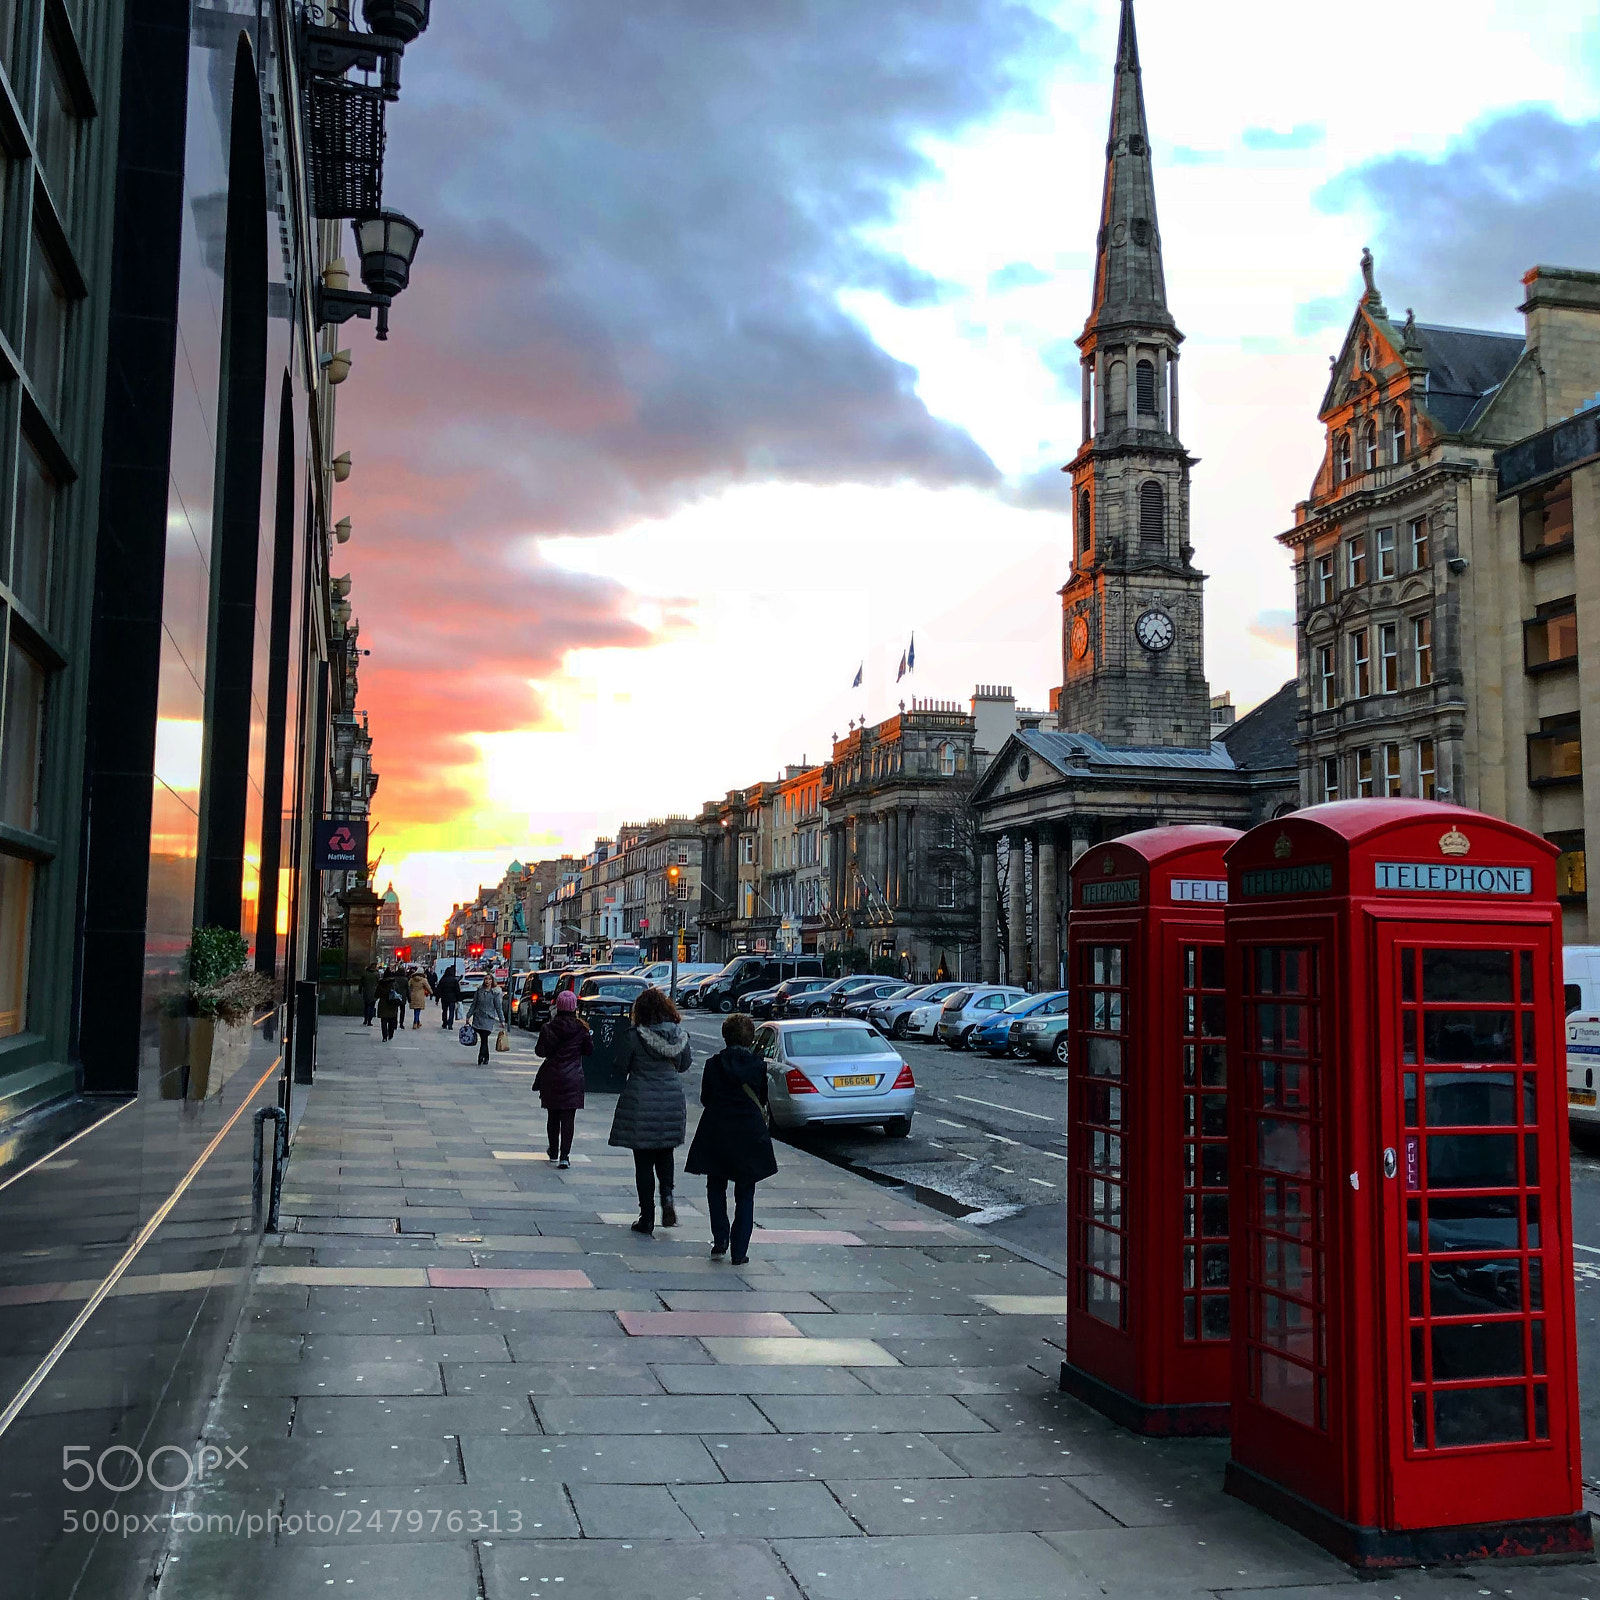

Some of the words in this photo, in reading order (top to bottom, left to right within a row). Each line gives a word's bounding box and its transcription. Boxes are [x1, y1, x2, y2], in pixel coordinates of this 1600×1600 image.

[327, 853, 355, 861] NatWest
[1084, 881, 1139, 902] TELEPHONE
[1244, 867, 1331, 895] TELEPHONE
[1380, 865, 1525, 892] TELEPHONE
[1407, 1142, 1415, 1184] PULL
